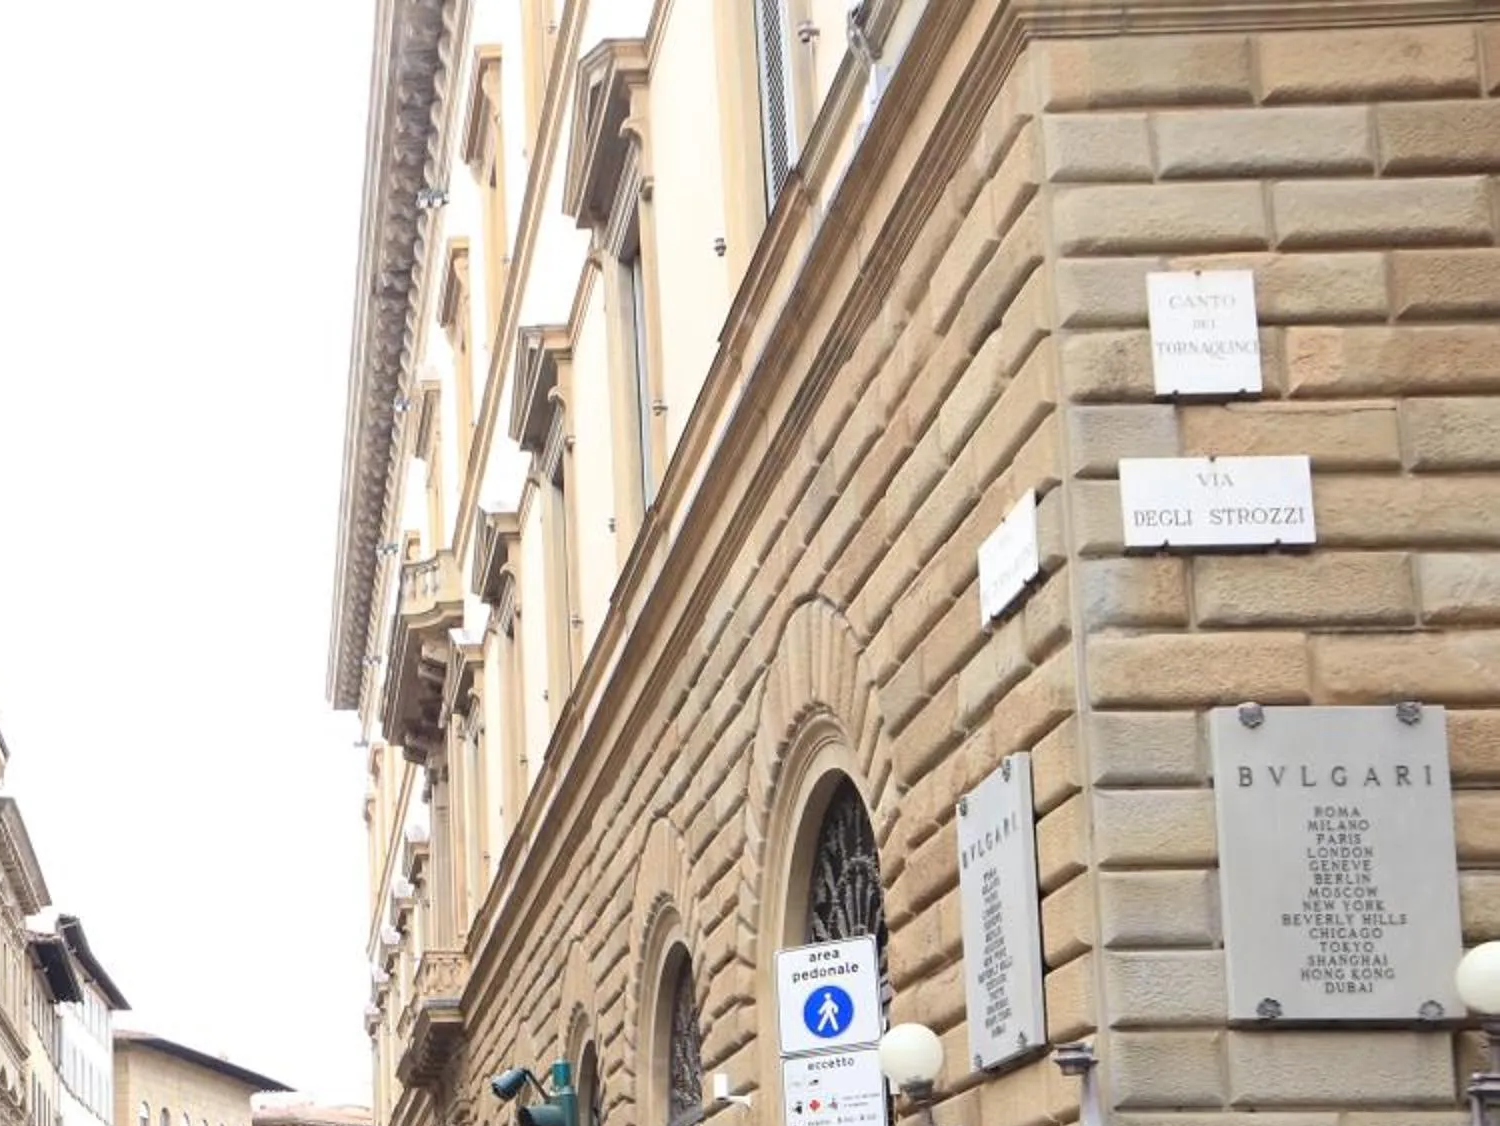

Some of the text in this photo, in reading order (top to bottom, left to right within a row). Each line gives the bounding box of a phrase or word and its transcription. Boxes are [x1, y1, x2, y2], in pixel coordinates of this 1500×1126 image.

[1168, 294, 1236, 310] CANTO
[1197, 472, 1235, 487] VIA
[1133, 505, 1306, 527] DEGLI STROZZI
[1238, 765, 1433, 788] BVLGARI
[1314, 806, 1361, 818] ROMA
[1307, 819, 1370, 832] MILANO
[1316, 833, 1362, 845] PARIS
[1307, 847, 1373, 859] LONDON
[1308, 860, 1372, 872] GENEVE
[1314, 873, 1372, 885] BERLIN
[1307, 887, 1378, 899] MOSCOW
[1302, 900, 1385, 912] NEW YORK
[1282, 914, 1407, 926] BEVERLY HILLS
[1308, 928, 1383, 940] CHICAGO
[1320, 941, 1374, 953] TOKYO
[808, 949, 840, 963] area
[1307, 954, 1388, 967] SHANGHAI
[792, 961, 860, 983] pedonale
[1300, 968, 1395, 980] HONG KONG
[1324, 982, 1373, 994] DUBAI
[807, 1056, 855, 1072] eccetto
